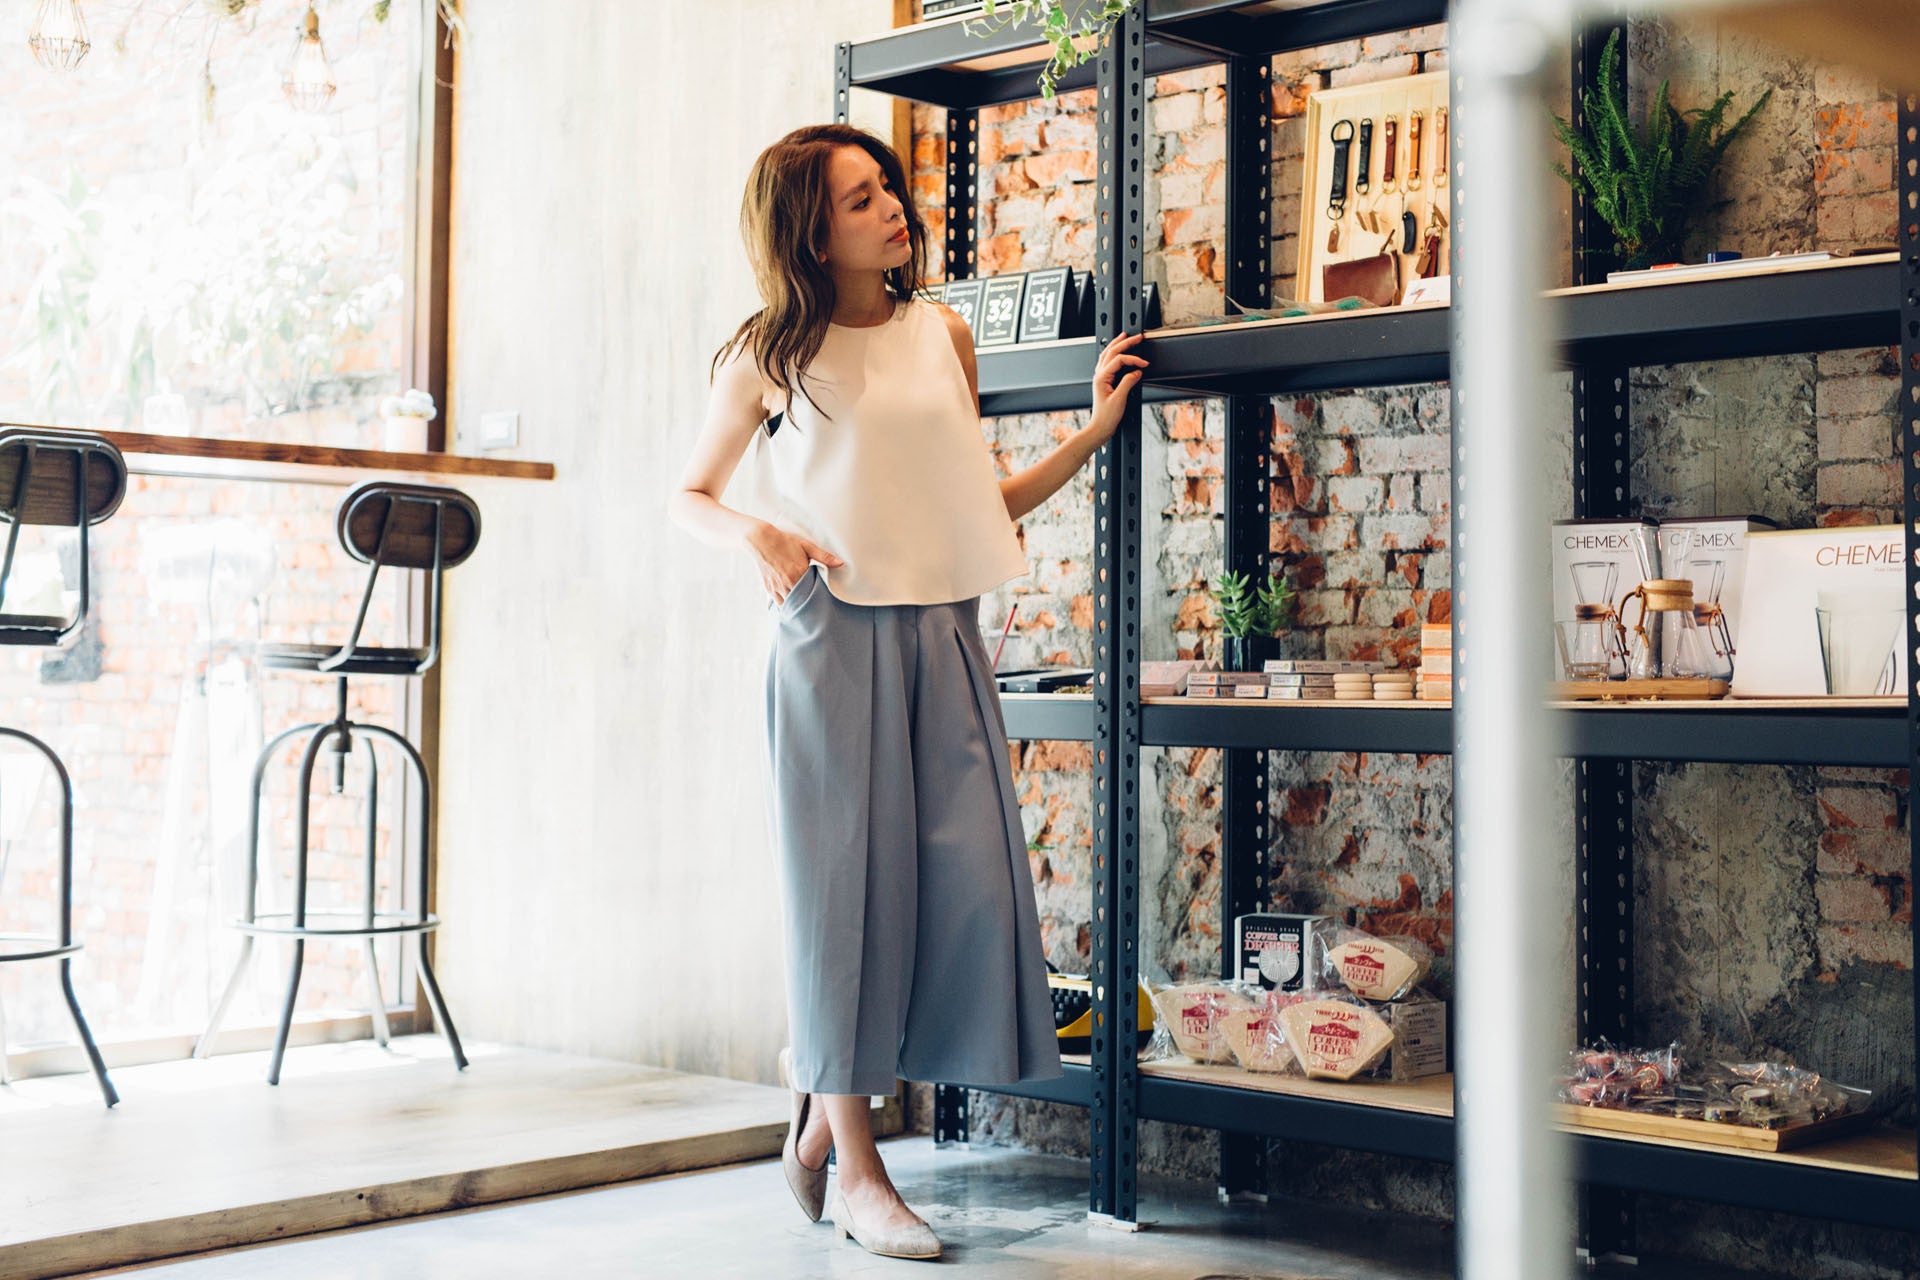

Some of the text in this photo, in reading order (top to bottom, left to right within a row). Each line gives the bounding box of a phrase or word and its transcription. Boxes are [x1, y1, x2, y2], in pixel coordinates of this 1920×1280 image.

[986, 297, 1014, 323] 32
[1029, 291, 1056, 318] 51
[1564, 534, 1629, 550] CHEMEX
[1245, 931, 1279, 941] COFFEE
[1244, 940, 1300, 953] DRIPPER
[1347, 972, 1377, 983] FILTER
[1313, 1035, 1351, 1048] COFFEE
[1313, 1044, 1351, 1056] FILTER
